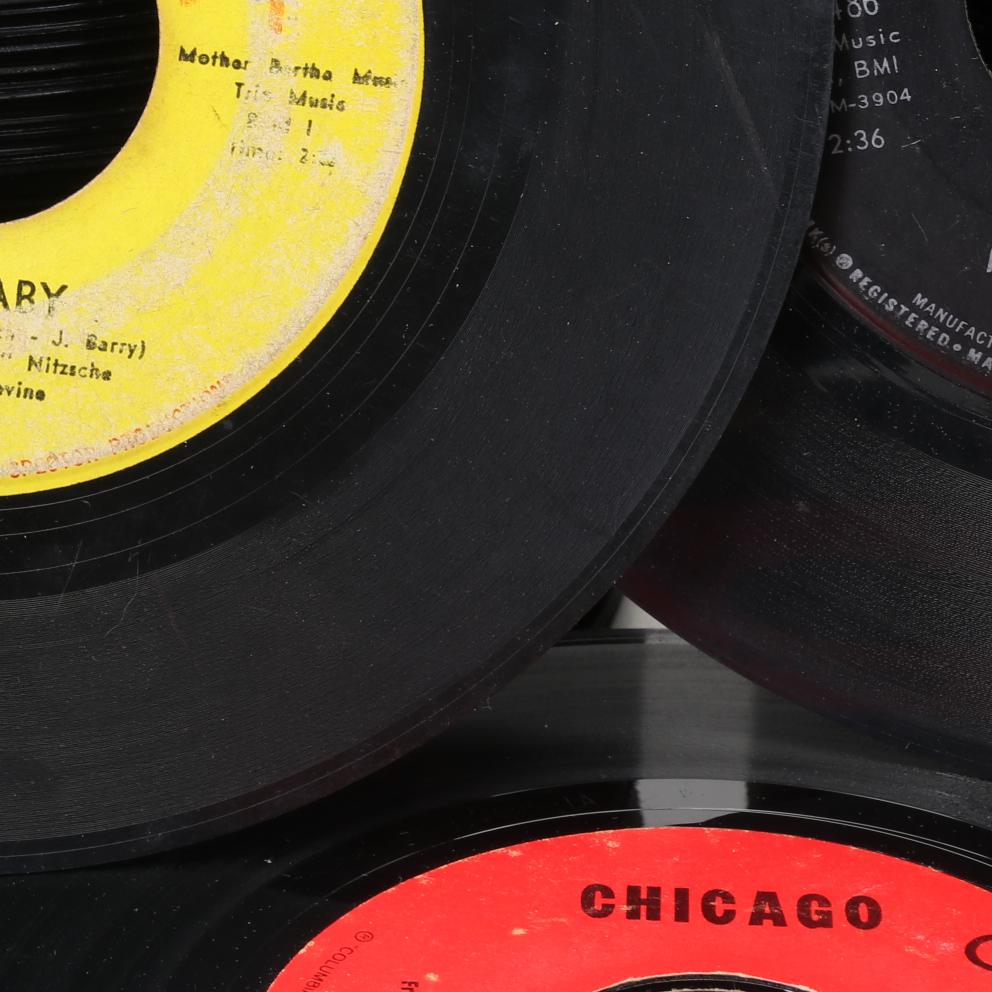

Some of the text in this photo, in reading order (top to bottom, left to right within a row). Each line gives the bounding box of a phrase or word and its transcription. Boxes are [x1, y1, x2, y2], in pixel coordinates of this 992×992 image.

[179, 45, 248, 71] Mother
[854, 55, 900, 79] BMI
[828, 127, 885, 156] 2:36
[85, 333, 147, 360] Barry)
[26, 354, 113, 381] Nitzsche
[579, 883, 885, 931] CHICAGO
